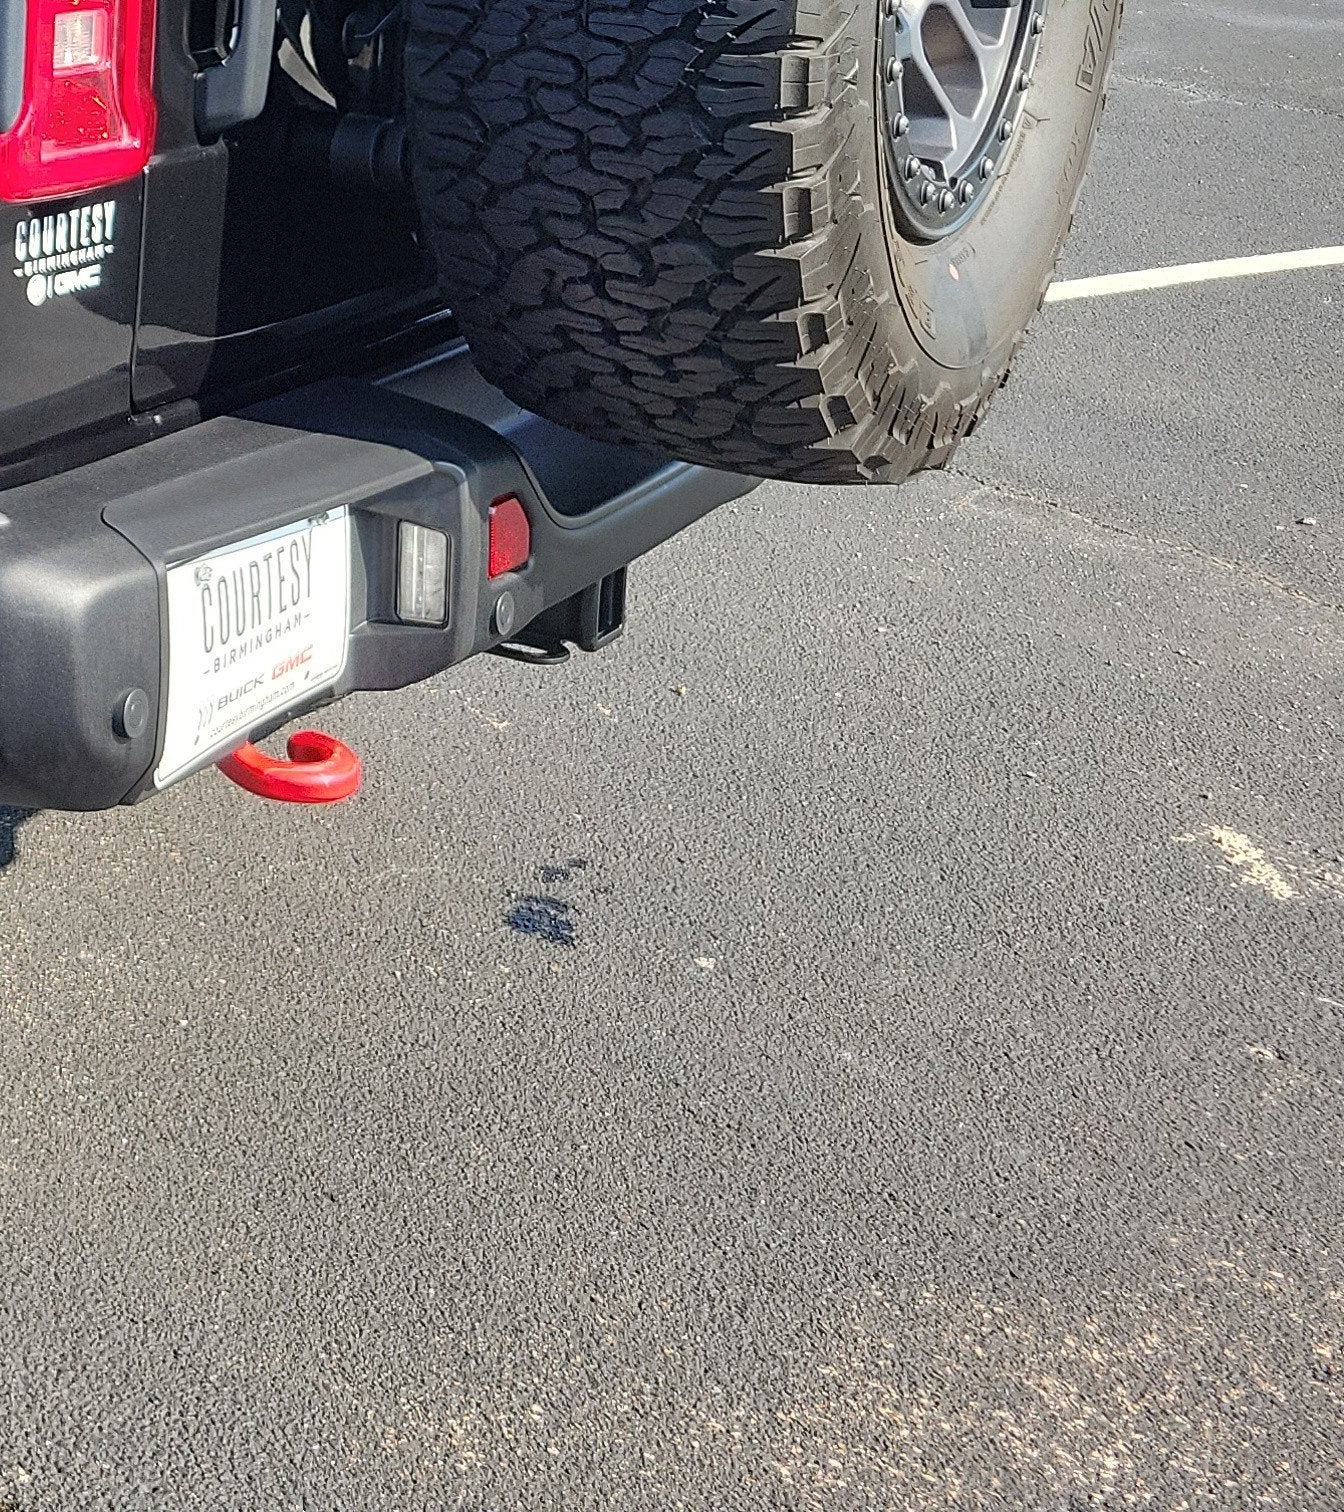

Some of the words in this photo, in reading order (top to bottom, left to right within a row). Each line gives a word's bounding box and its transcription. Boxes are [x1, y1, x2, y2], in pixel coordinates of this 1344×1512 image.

[15, 200, 115, 262] COURTESY
[53, 263, 102, 296] GMC
[201, 527, 313, 653] COURTESY
[214, 614, 301, 674] BIRMINGHAM
[217, 673, 265, 710] BUICK
[271, 644, 313, 680] GMC
